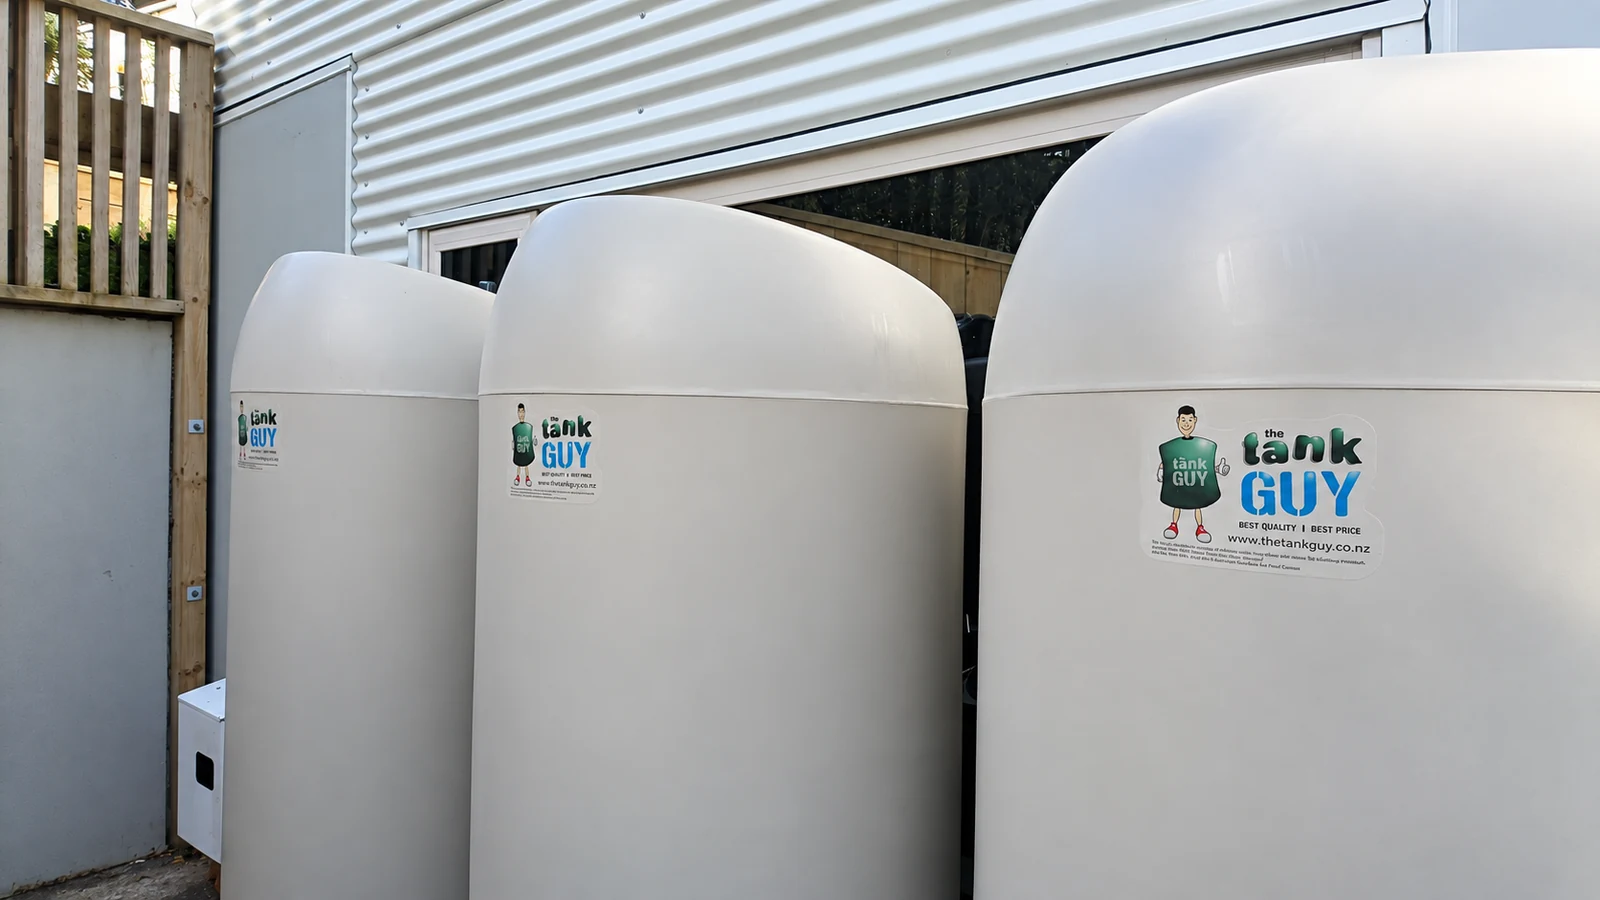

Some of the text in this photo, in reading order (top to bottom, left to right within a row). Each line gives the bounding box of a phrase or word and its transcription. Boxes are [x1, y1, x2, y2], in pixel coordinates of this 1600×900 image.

[542, 415, 592, 439] tank
[1265, 429, 1284, 438] the
[251, 428, 277, 447] GUY
[1242, 427, 1363, 466] tank
[542, 441, 592, 469] GUY
[1172, 470, 1208, 486] GUY
[1241, 471, 1361, 517] GUY
[1238, 521, 1259, 530] BEST
[1261, 522, 1297, 532] QUALITY
[1311, 525, 1333, 534] BEST
[1335, 526, 1361, 535] PRICE
[1227, 534, 1371, 554] www.thetankguy.co.nz
